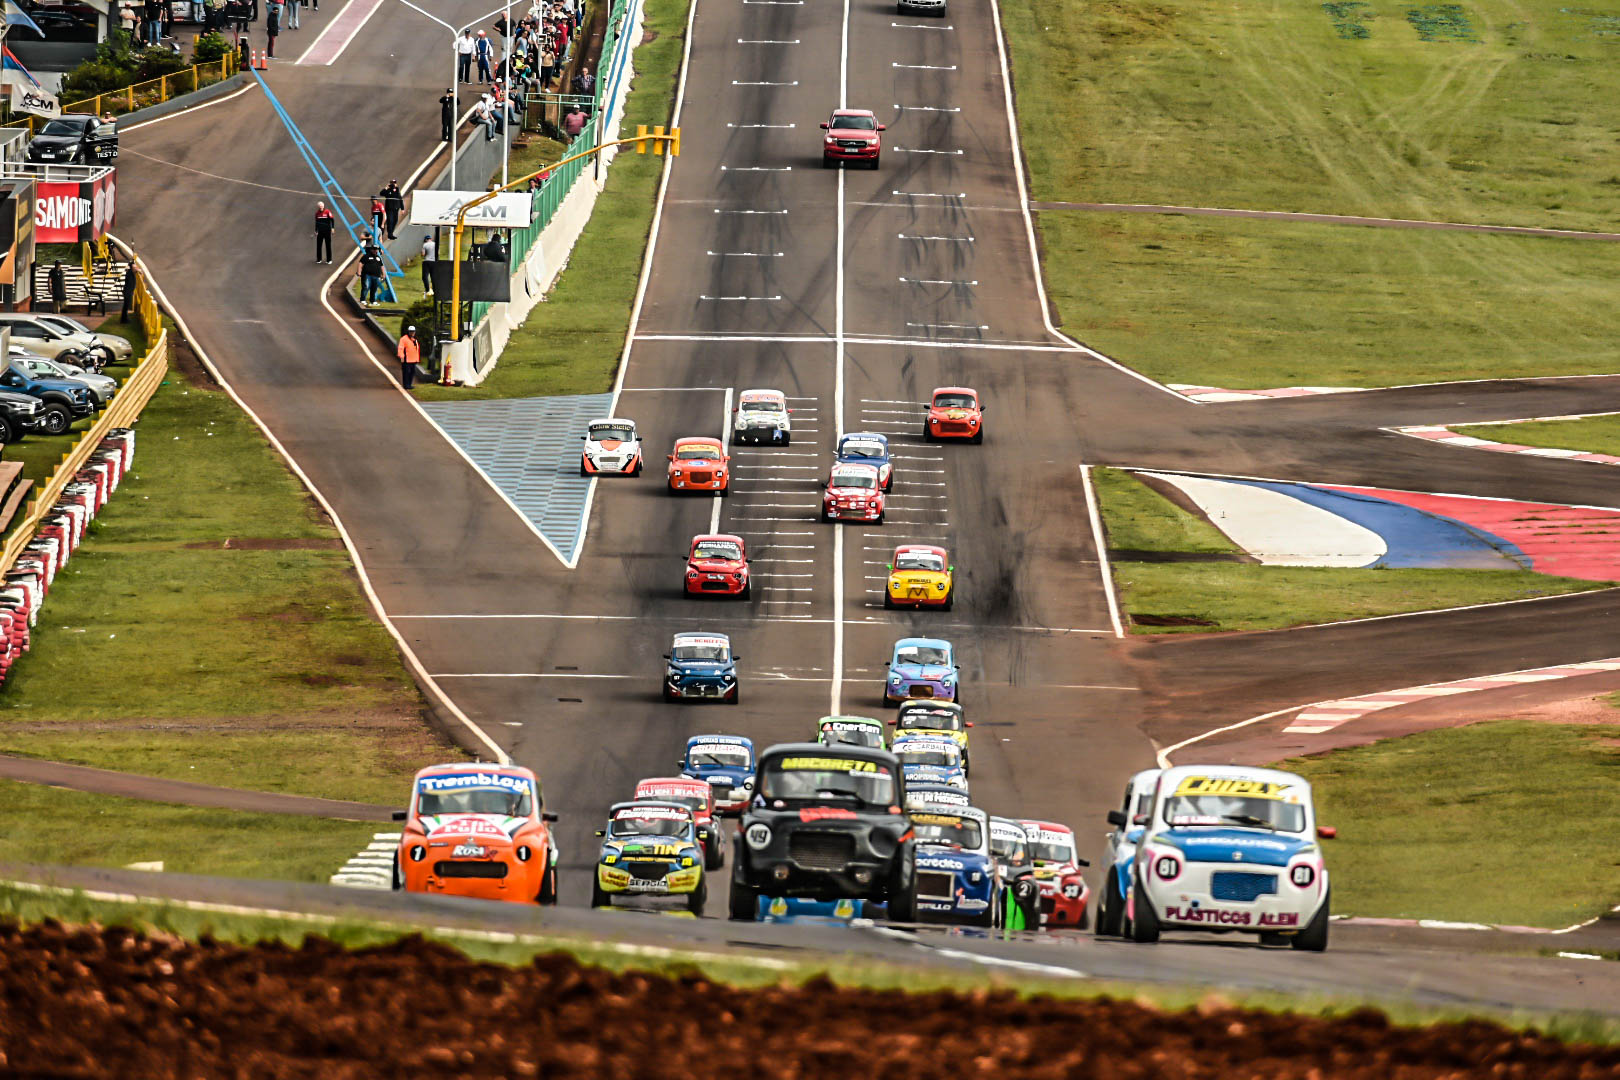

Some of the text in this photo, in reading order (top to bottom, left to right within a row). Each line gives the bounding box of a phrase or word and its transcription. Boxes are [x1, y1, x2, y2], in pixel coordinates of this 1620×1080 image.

[35, 195, 92, 229] SAMONTE
[420, 773, 529, 792] Tremblay
[1175, 776, 1294, 800] CHIPLY
[751, 829, 768, 843] 49
[415, 846, 422, 861] 1
[520, 846, 526, 861] 1
[1158, 860, 1176, 876] 81
[1293, 867, 1310, 883] 81
[1019, 884, 1028, 896] 2
